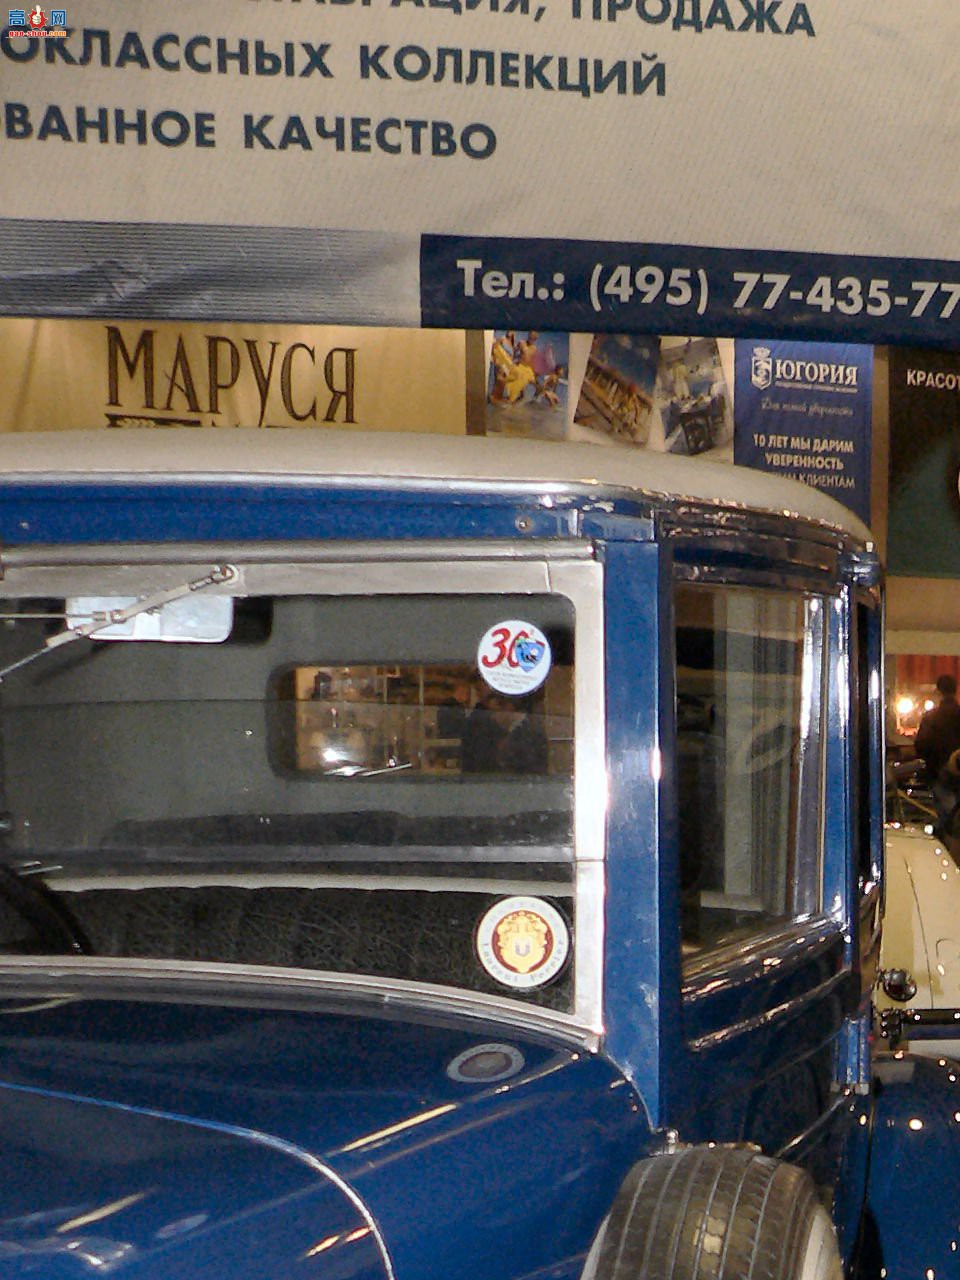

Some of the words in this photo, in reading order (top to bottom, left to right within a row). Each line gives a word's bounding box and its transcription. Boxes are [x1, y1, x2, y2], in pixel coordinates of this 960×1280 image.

[0, 27, 334, 78] ОКЛАССНЫХ
[359, 44, 666, 98] КОЛЛЕКЦИЙ
[243, 114, 497, 160] КАЧЕСТВО
[457, 259, 566, 299] Тел.:
[589, 263, 709, 315] (495)
[776, 359, 858, 386] ЮГОРИЯ
[753, 433, 766, 447] 10
[768, 435, 788, 449] ЛЕТ
[790, 436, 811, 450] МЫ
[812, 438, 854, 453] ДАРИМ
[765, 452, 844, 470] УВЕРЕННОСТЬ
